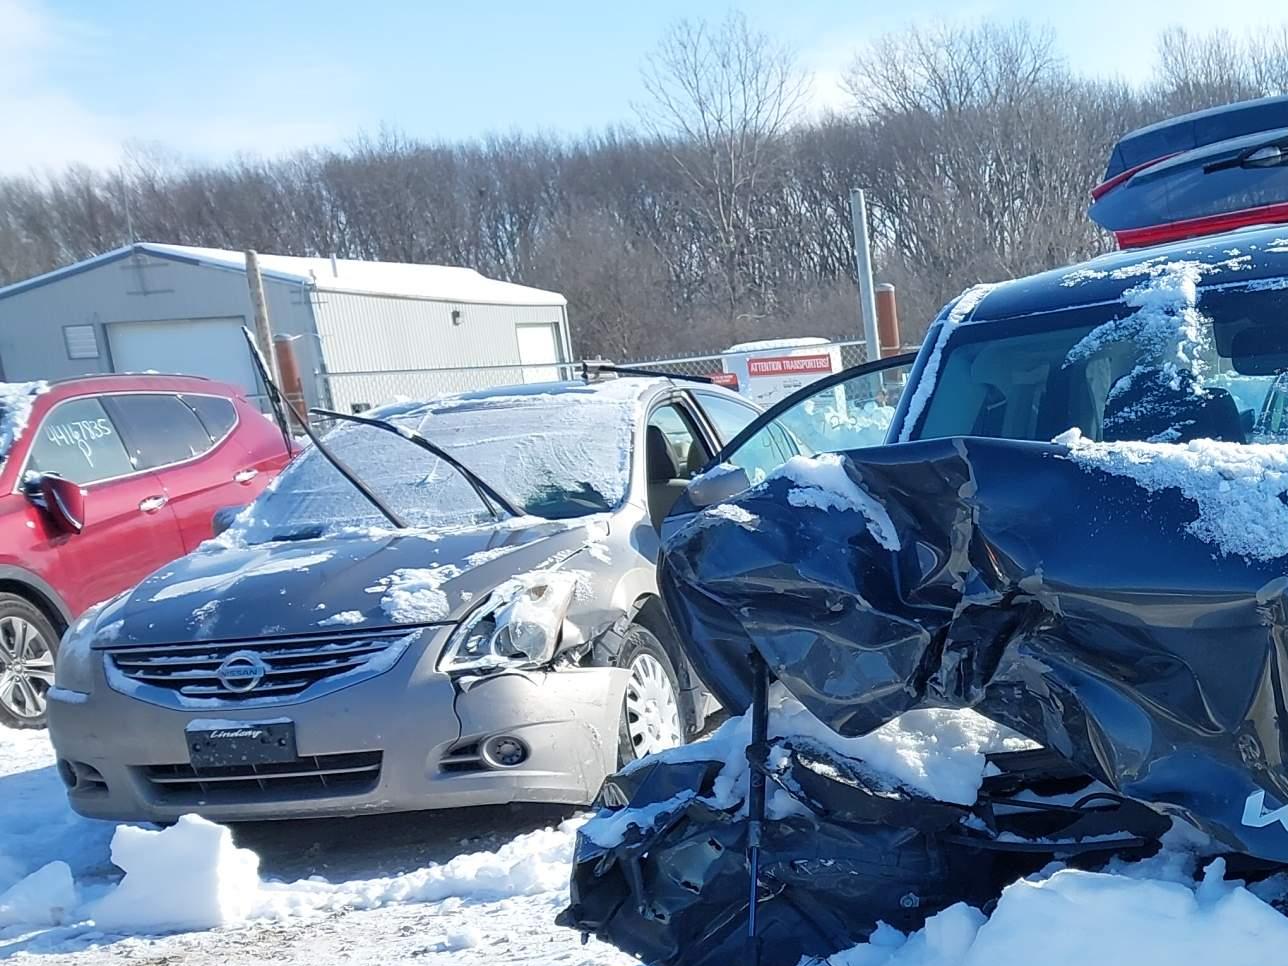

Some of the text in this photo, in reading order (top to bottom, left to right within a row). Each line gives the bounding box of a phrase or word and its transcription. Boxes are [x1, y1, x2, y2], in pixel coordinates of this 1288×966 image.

[750, 360, 782, 373] ATTENTION
[47, 418, 112, 447] 44167835
[222, 669, 258, 678] NISSAN
